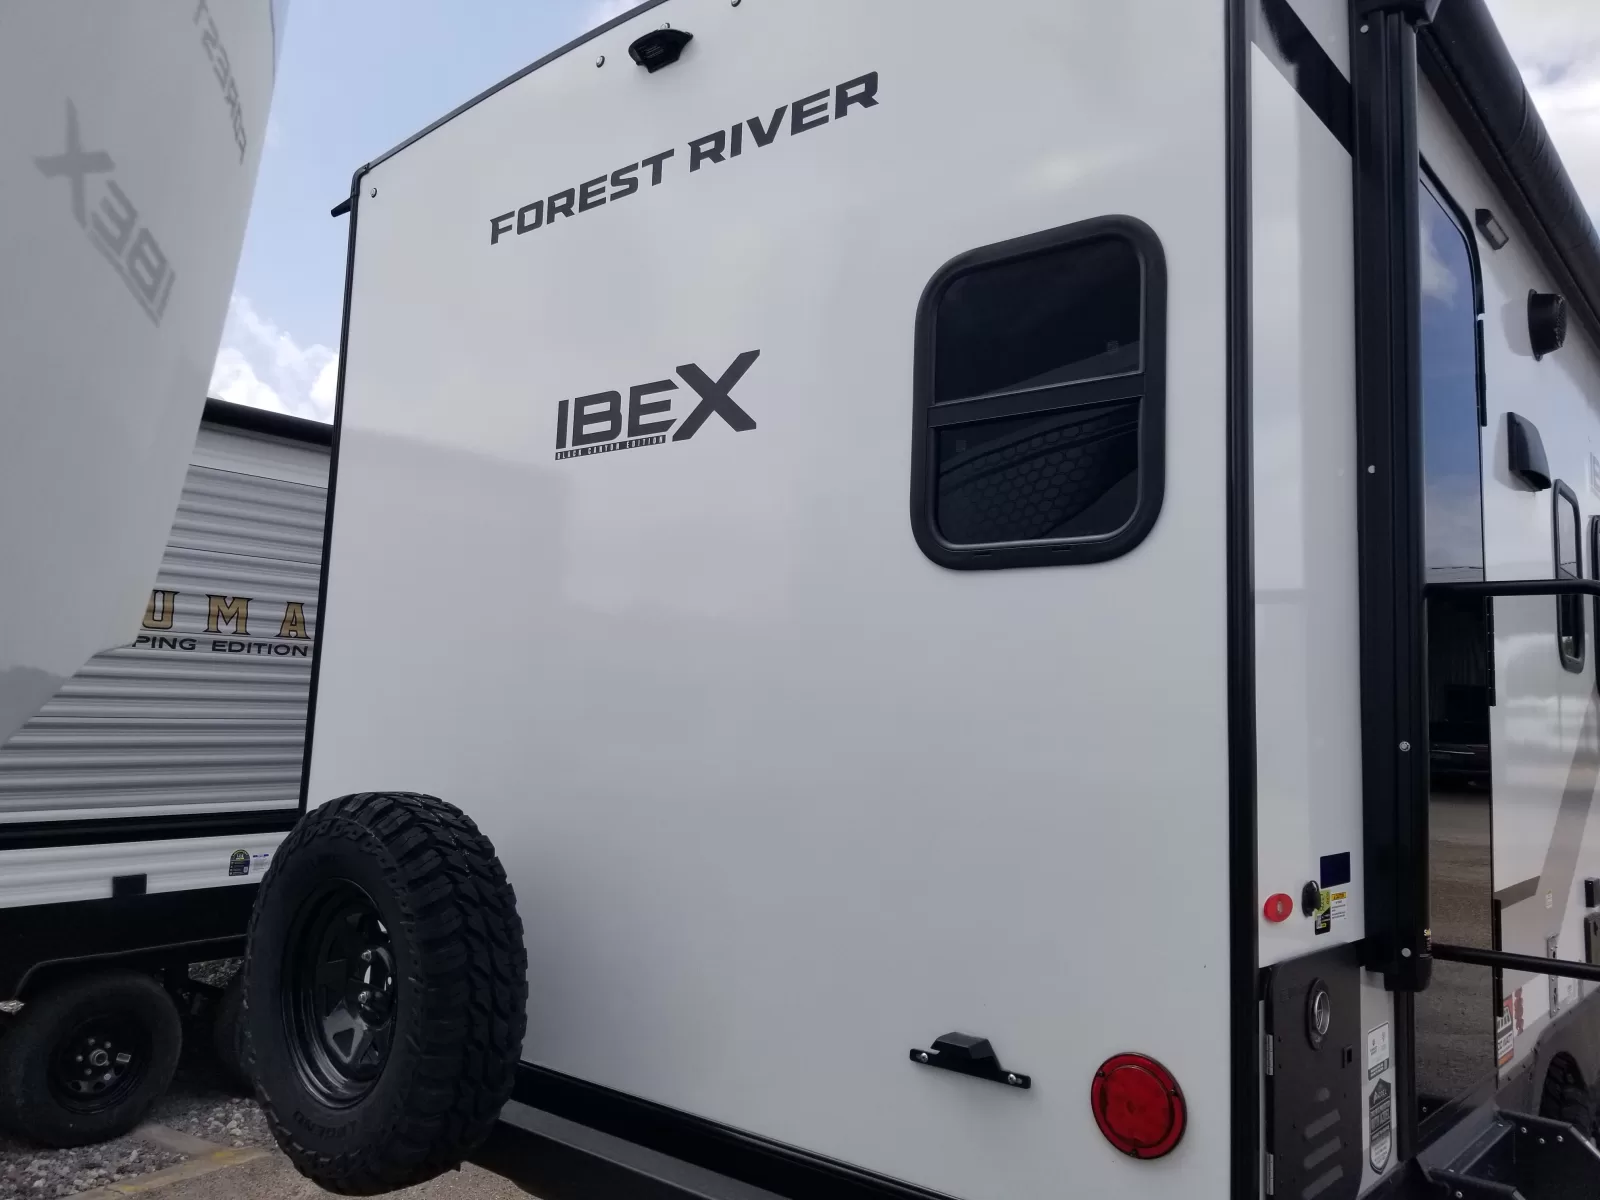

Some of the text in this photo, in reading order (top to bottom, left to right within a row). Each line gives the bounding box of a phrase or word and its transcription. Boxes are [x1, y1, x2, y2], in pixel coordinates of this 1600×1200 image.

[489, 70, 880, 246] FOREST RIVER
[555, 348, 761, 450] IBEX
[626, 435, 664, 449] EDITION
[211, 639, 309, 657] EDITION
